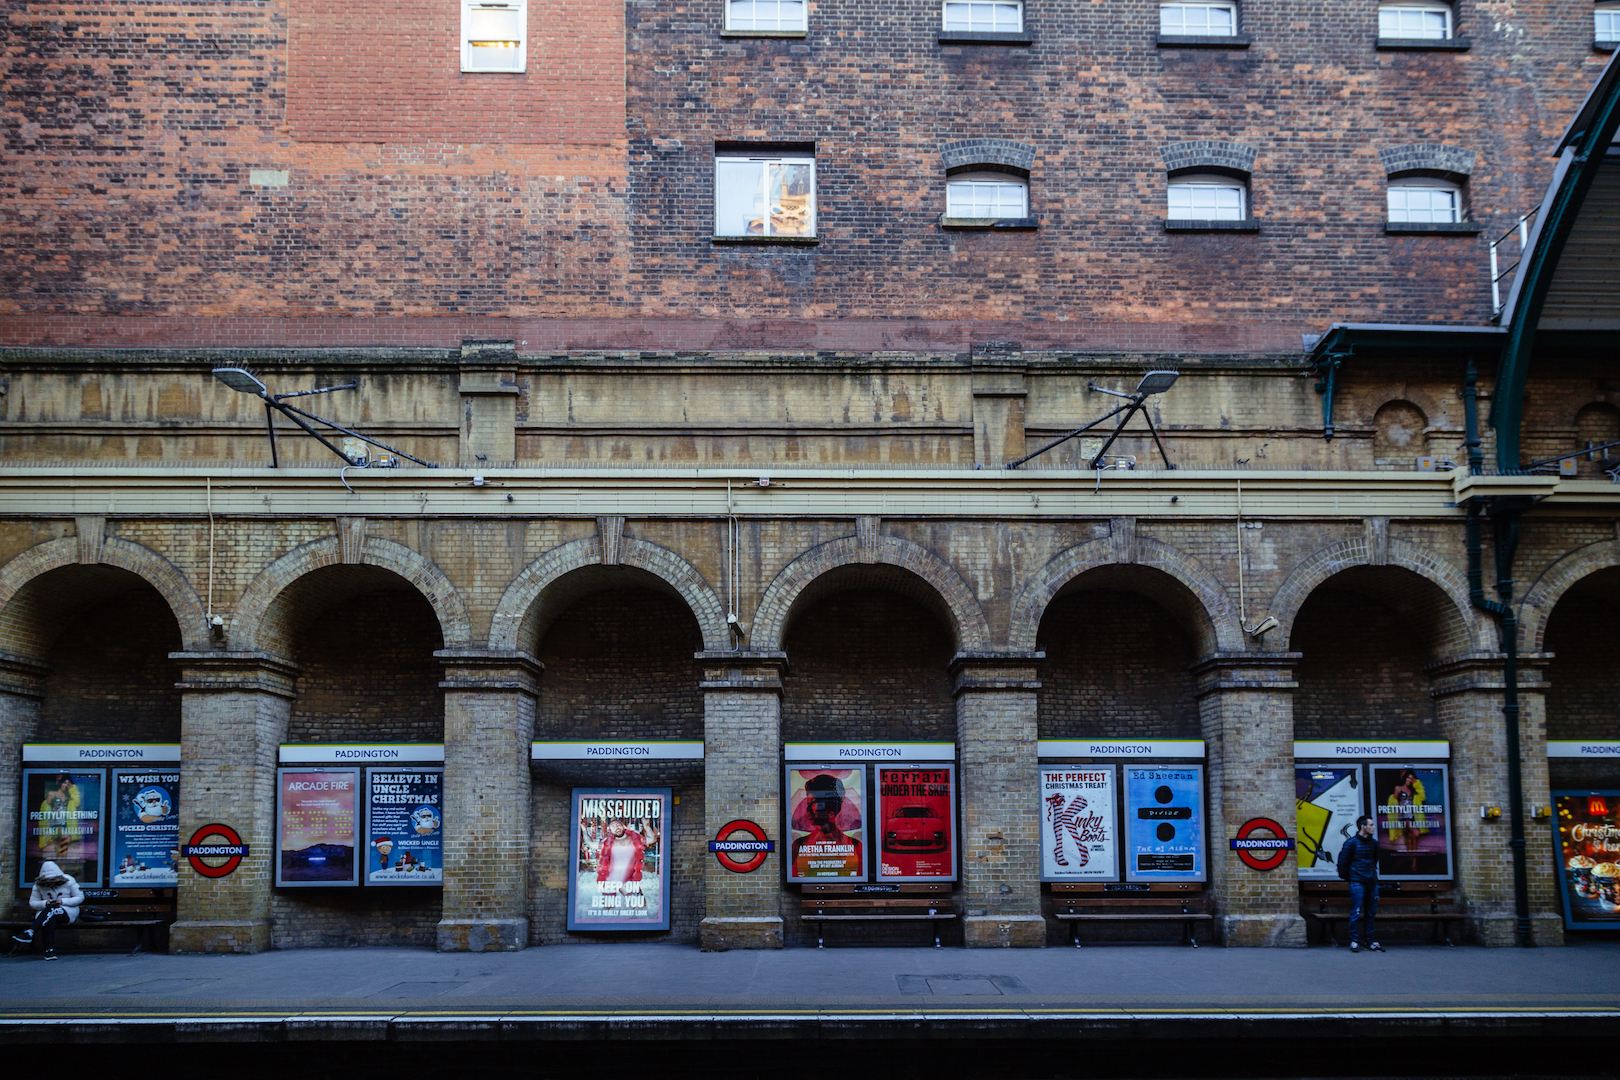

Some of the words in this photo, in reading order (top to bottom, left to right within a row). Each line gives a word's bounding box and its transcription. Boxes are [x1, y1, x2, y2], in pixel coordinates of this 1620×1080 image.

[79, 749, 143, 758] PADDINGTON
[335, 749, 399, 758] PADDINGTON
[586, 747, 650, 755] PADDINGTON
[839, 748, 902, 757] PADDINGTON
[1090, 745, 1152, 754] PADDINGTON
[1335, 746, 1397, 755] PADDINGTON
[119, 775, 134, 783] WE
[135, 775, 160, 783] WISH
[161, 774, 179, 783] YOU
[372, 774, 421, 784] BELIEVE
[424, 774, 438, 784] IN
[880, 770, 949, 783] Ferrari
[1045, 773, 1063, 782] THE
[1066, 772, 1106, 782] PERFECT
[1132, 772, 1146, 780] Ed
[1148, 772, 1194, 780] Sheeran
[288, 781, 328, 791] ARCADE
[330, 781, 349, 790] FIRE
[372, 784, 410, 794] UNCLE
[881, 784, 910, 797] UNDER
[910, 784, 927, 797] THE
[928, 784, 949, 797] SKIN
[372, 794, 438, 804] CHRISTMAS
[582, 799, 660, 819] MISSGUIDED
[1378, 804, 1443, 814] PRETTYLITTLETHING
[30, 810, 98, 821] PRETTYLITTLETHING
[1080, 829, 1110, 842] Boots
[715, 842, 768, 850] PADDINGTON
[798, 844, 824, 853] ARETHA
[824, 844, 855, 853] FRANKLIN
[1236, 839, 1288, 848] PADDINGTON
[188, 846, 243, 855] PADDINGTON
[597, 880, 623, 894] KEEP
[625, 880, 640, 893] ON
[591, 895, 622, 908] BEING
[624, 895, 645, 908] YOU
